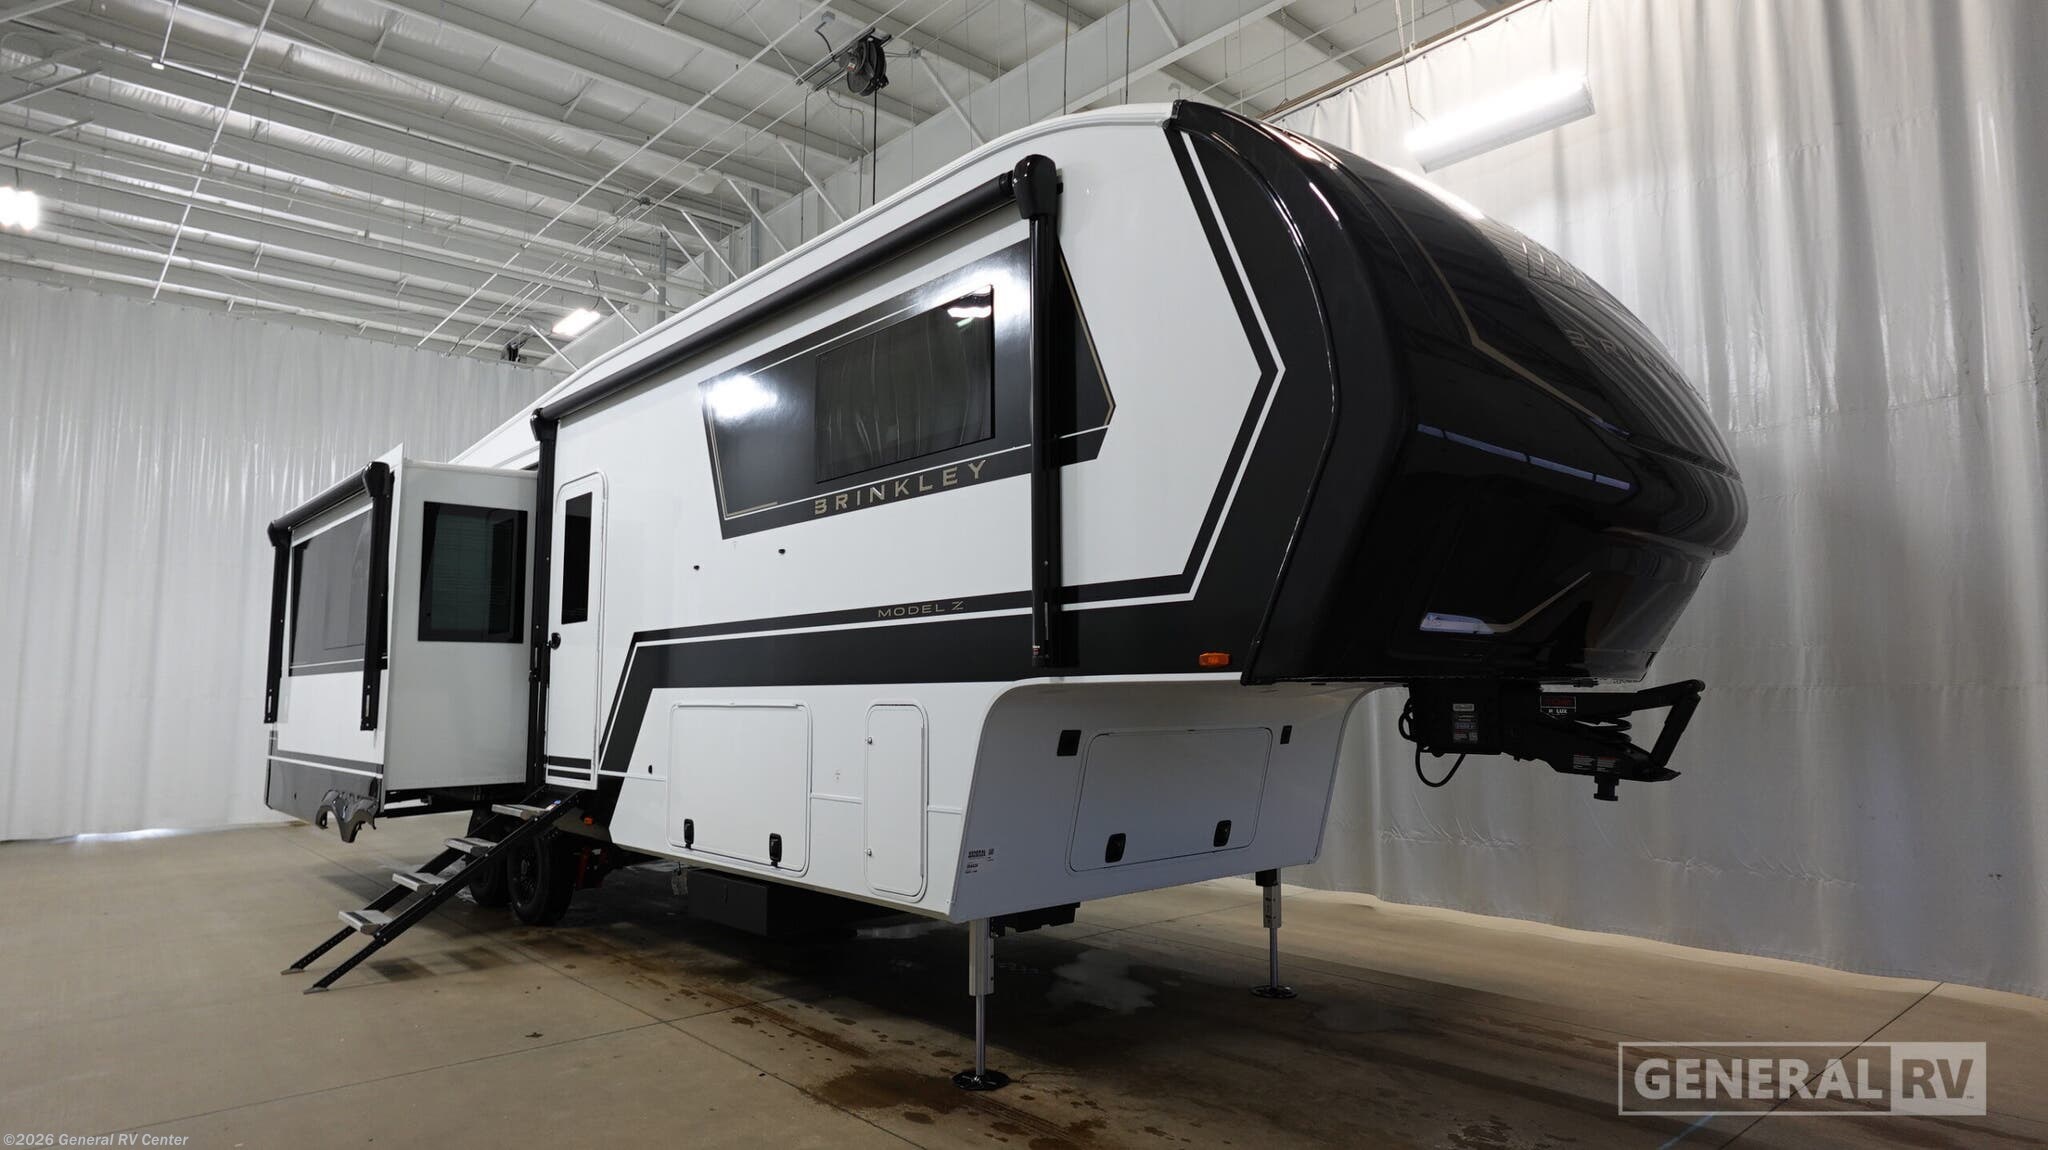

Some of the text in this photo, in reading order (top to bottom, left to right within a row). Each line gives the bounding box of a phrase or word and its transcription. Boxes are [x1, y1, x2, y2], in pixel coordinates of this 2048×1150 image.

[814, 459, 987, 515] BRINKLEY
[878, 600, 964, 618] MODEL Z
